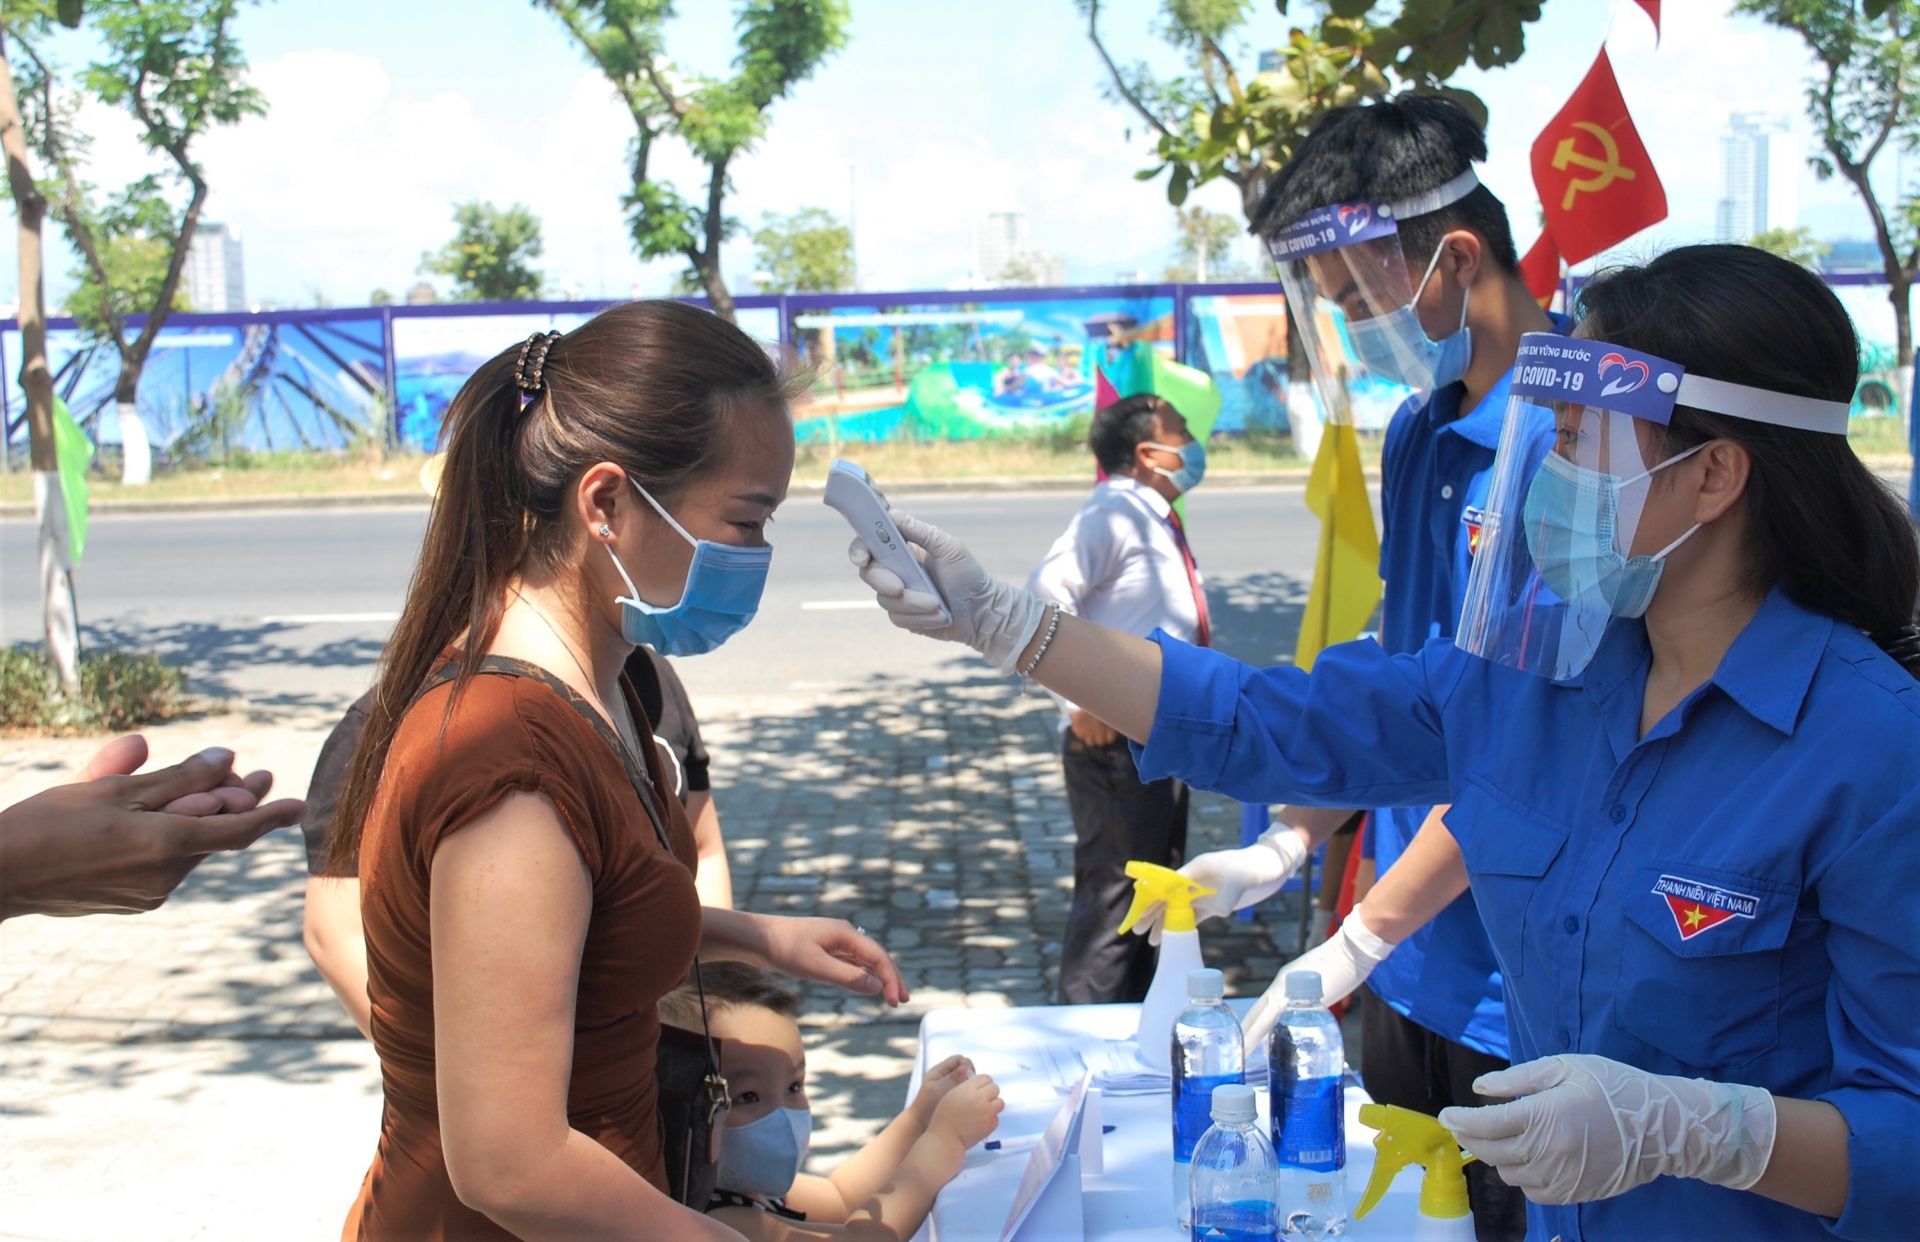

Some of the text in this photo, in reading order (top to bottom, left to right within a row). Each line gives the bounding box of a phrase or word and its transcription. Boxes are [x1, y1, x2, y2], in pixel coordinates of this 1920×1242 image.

[1288, 227, 1336, 252] COVID-19
[1539, 344, 1560, 358] VỮNG
[1561, 348, 1591, 362] BƯỚC
[1522, 365, 1584, 391] COVID-19
[1657, 880, 1686, 897] THANH
[1706, 890, 1728, 908] VIỆT
[1727, 897, 1754, 914] NAM
